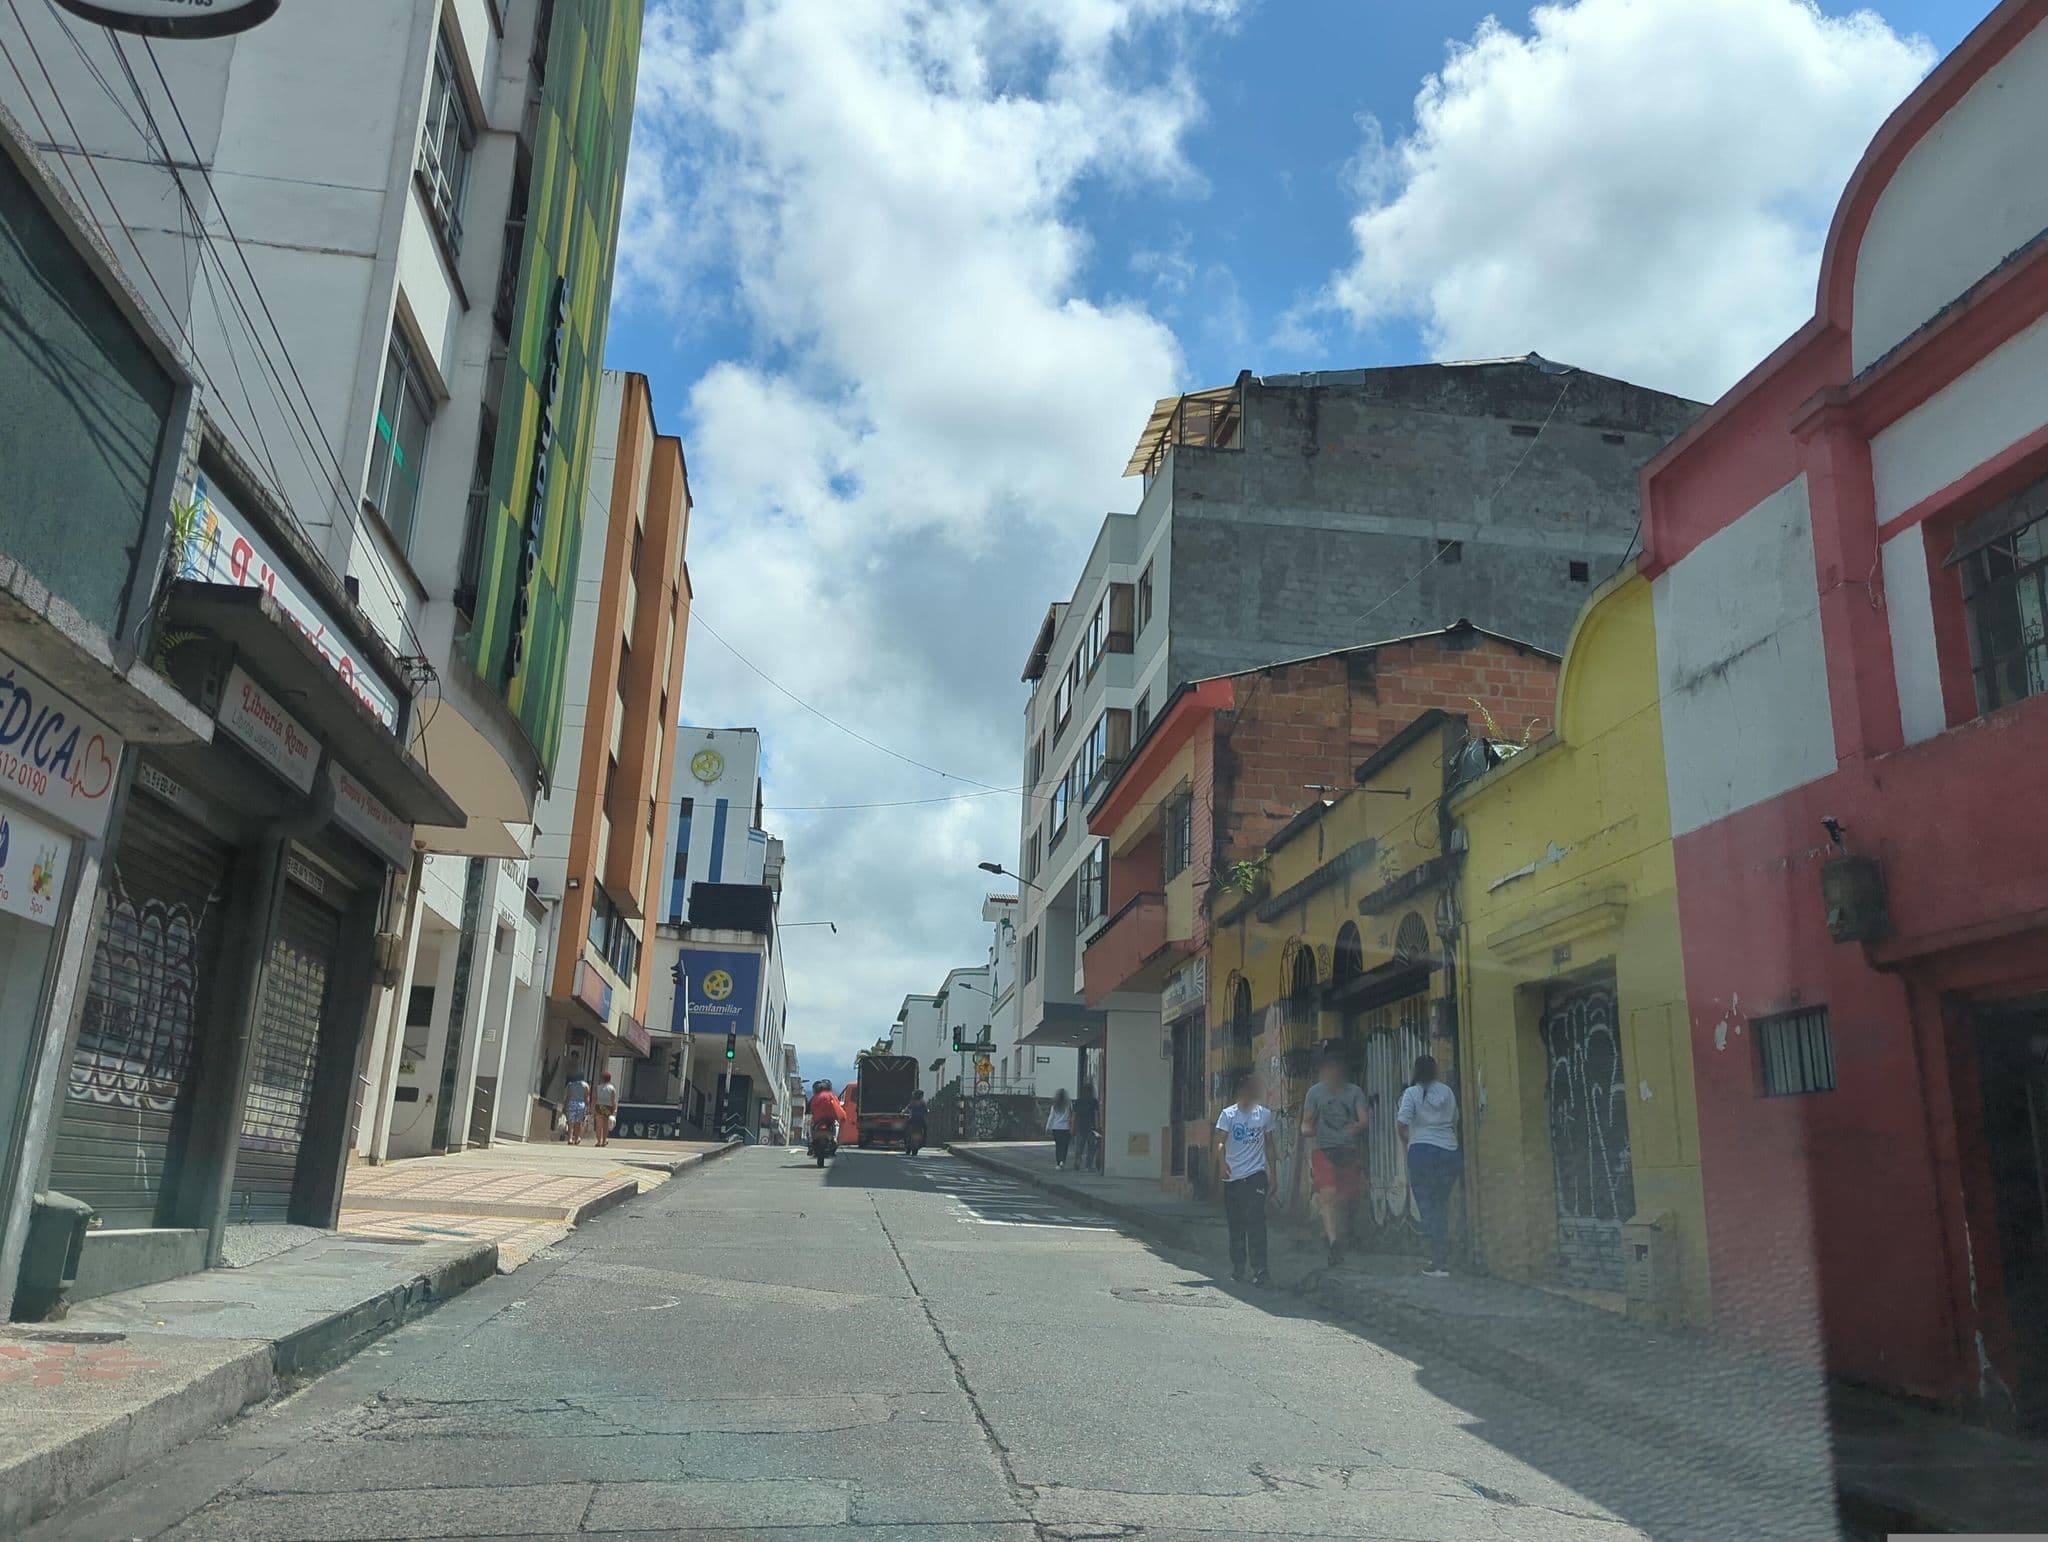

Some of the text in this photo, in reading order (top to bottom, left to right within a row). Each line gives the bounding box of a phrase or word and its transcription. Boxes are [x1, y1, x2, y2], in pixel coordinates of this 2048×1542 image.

[242, 684, 309, 760] Librería Roma
[18, 763, 48, 796] 0190
[30, 897, 43, 914] Spa
[688, 1001, 743, 1015] Comfamiliar
